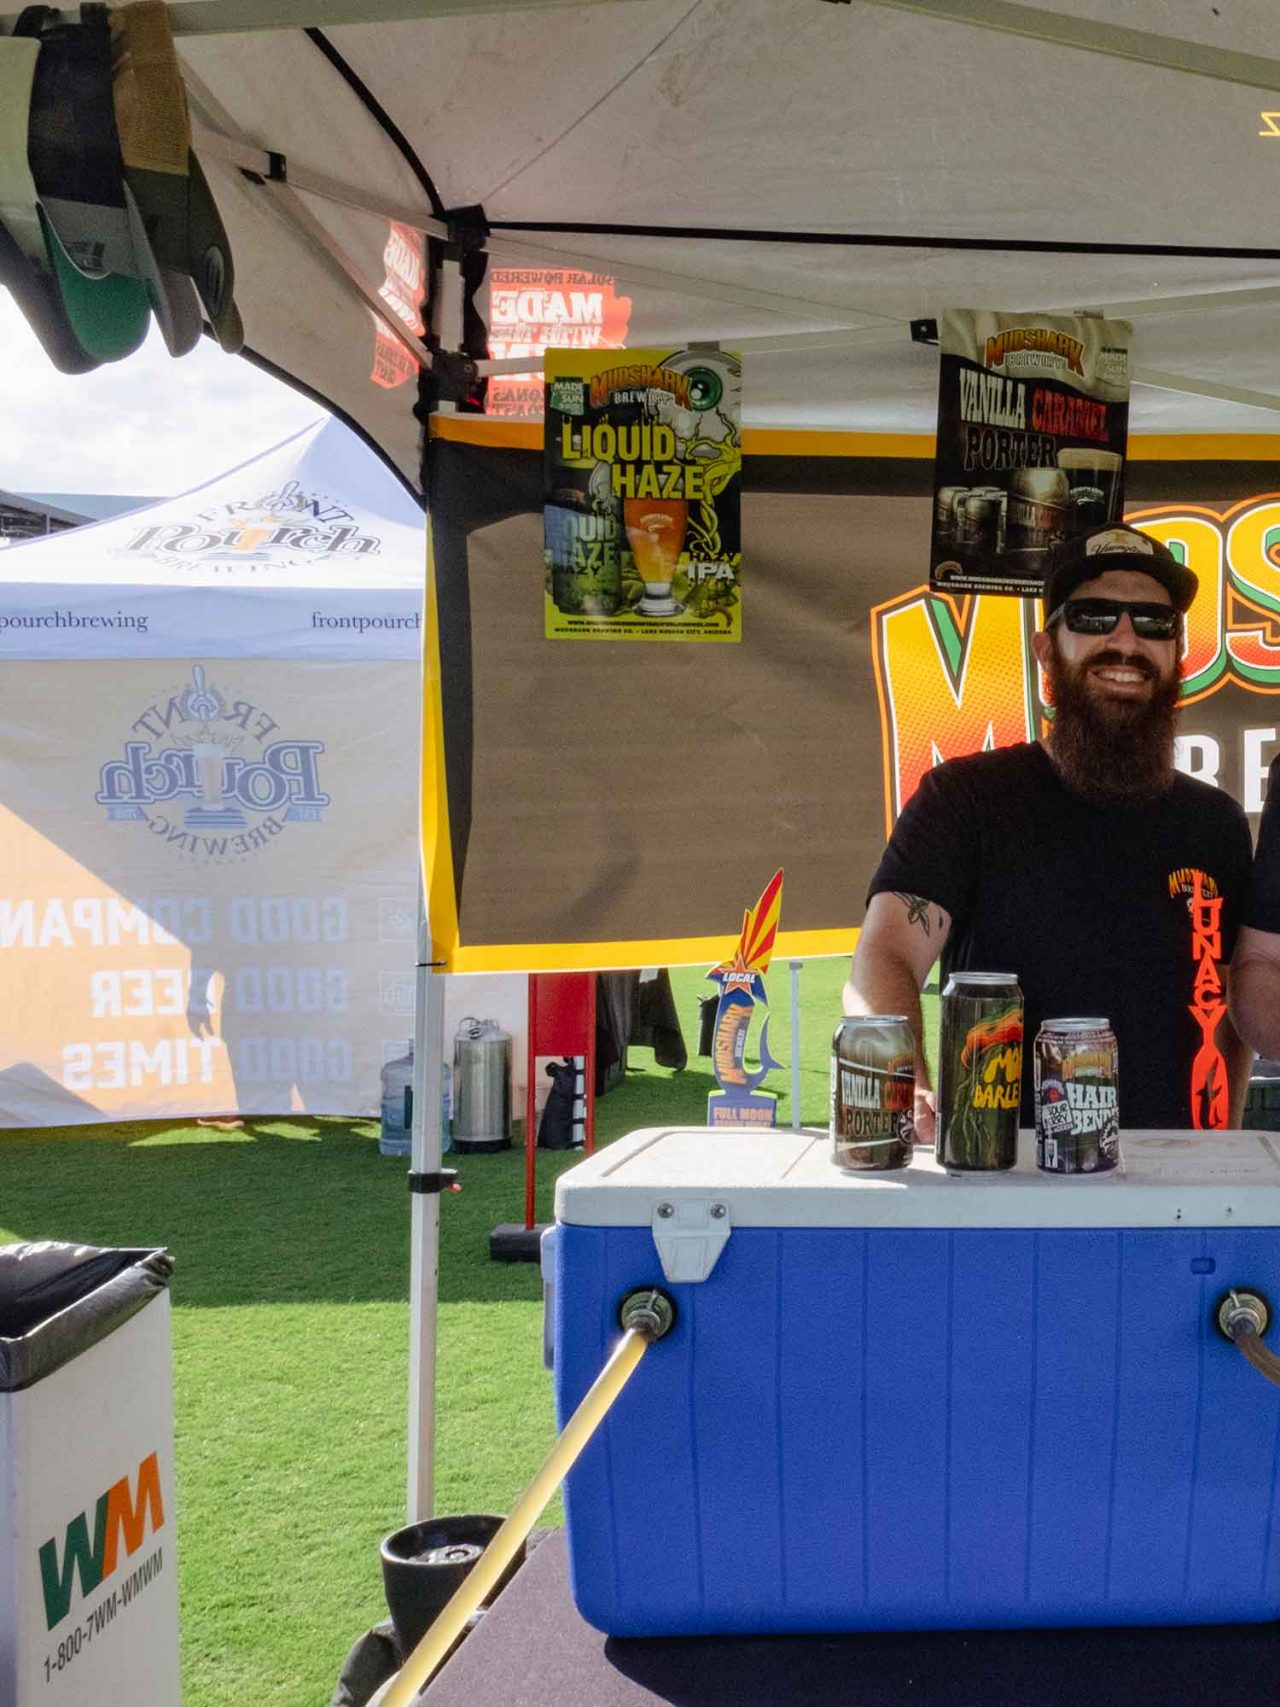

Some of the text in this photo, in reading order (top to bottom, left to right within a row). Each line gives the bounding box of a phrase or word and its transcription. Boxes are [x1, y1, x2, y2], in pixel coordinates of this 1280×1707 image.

[985, 329, 1086, 377] MUDSHARK
[590, 365, 693, 412] MUDSHARK
[959, 368, 1109, 442] VANILLA CARAMEL
[562, 417, 677, 463] LIQUID
[962, 427, 1057, 471] PORTER
[612, 463, 705, 499] HAZE
[128, 523, 381, 554] Pourch
[688, 563, 735, 581] IPA
[723, 973, 756, 983] LOCAL
[841, 1070, 881, 1109] VANILLA
[972, 1083, 1020, 1109] BARLE
[1066, 1082, 1117, 1109] HAIR
[39, 1451, 165, 1632] WM
[42, 1546, 164, 1684] 1-800-7WM-WMWM
